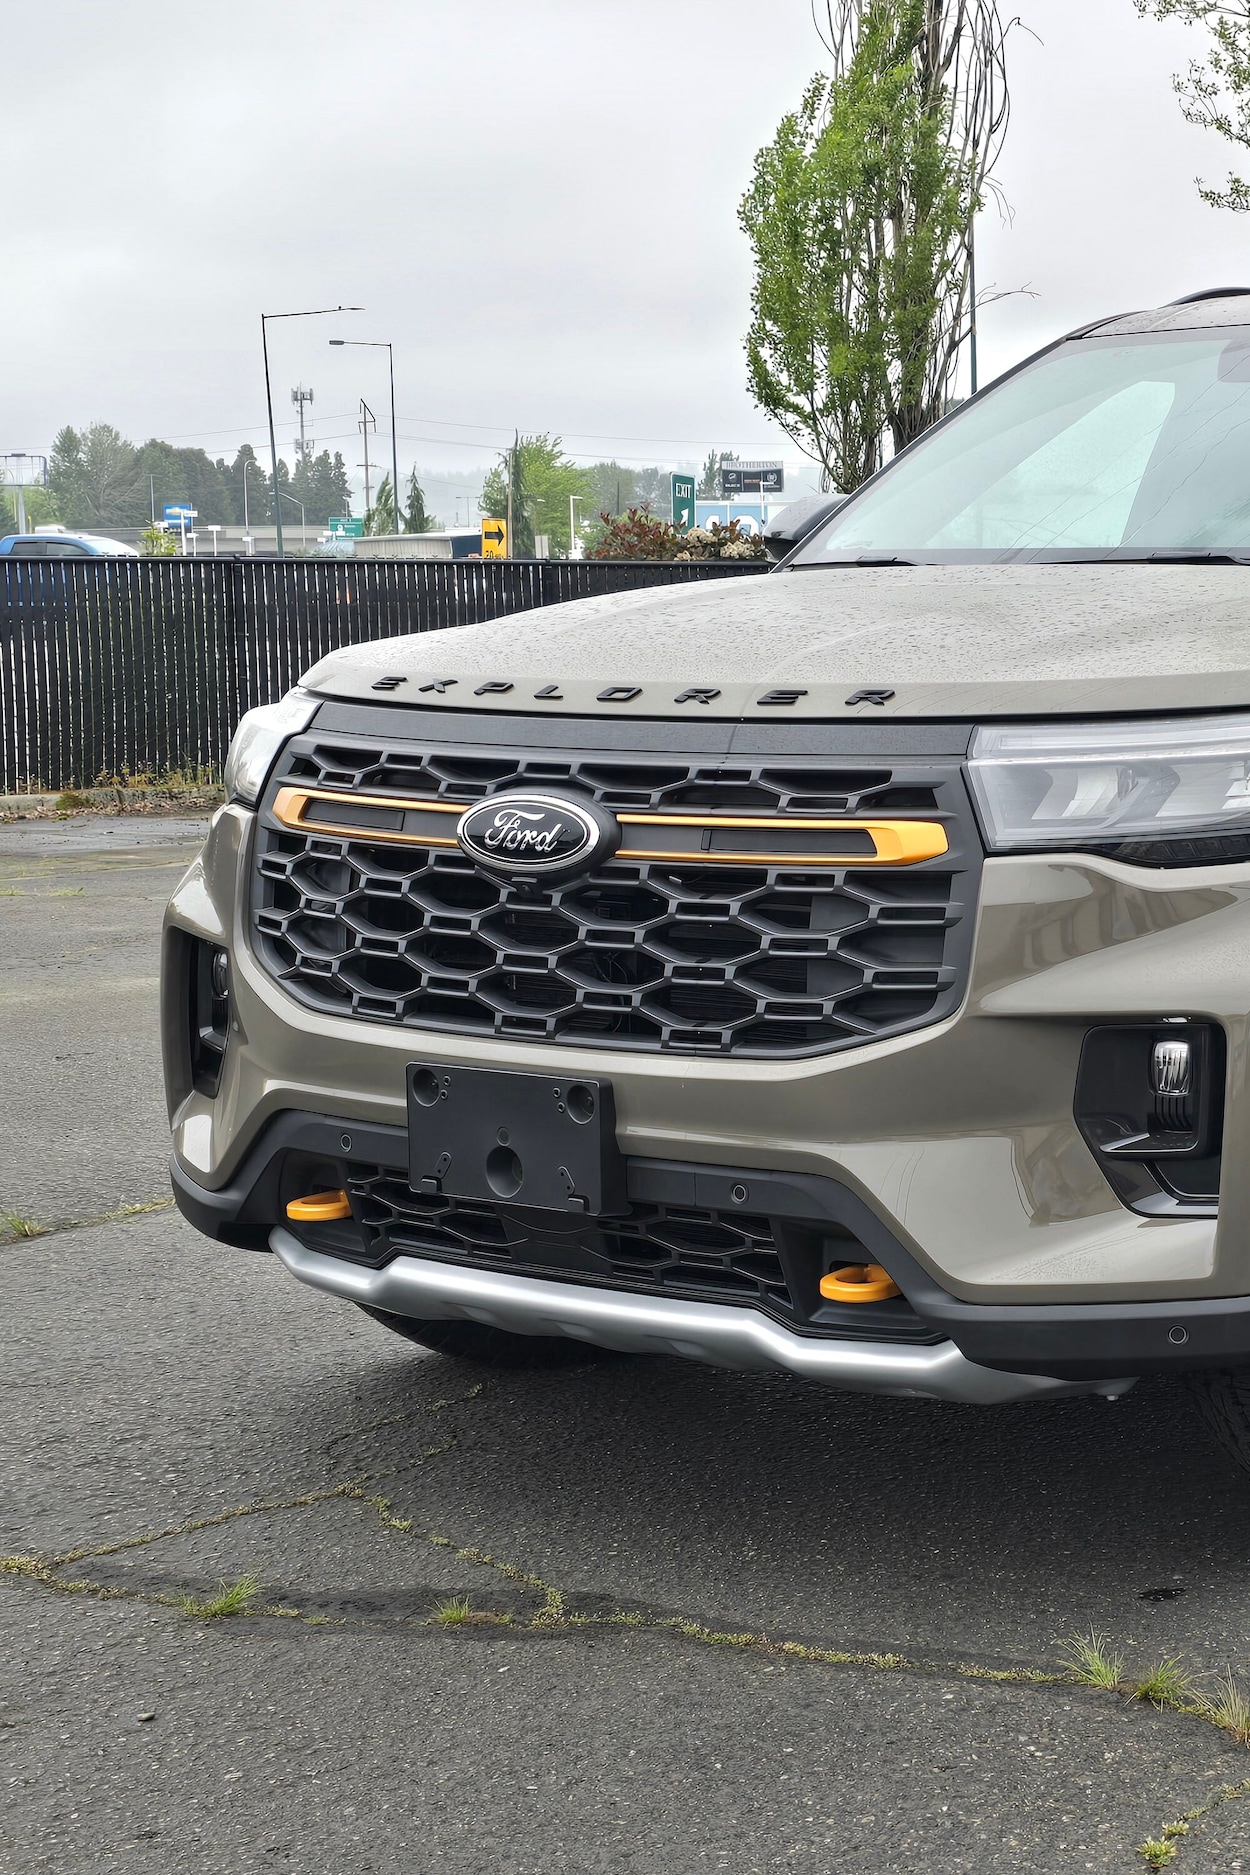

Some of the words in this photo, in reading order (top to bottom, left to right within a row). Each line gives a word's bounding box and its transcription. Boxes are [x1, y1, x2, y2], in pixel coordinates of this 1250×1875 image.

[675, 483, 692, 499] EXIT
[371, 675, 896, 706] EXPLORER
[484, 809, 562, 853] Ford
